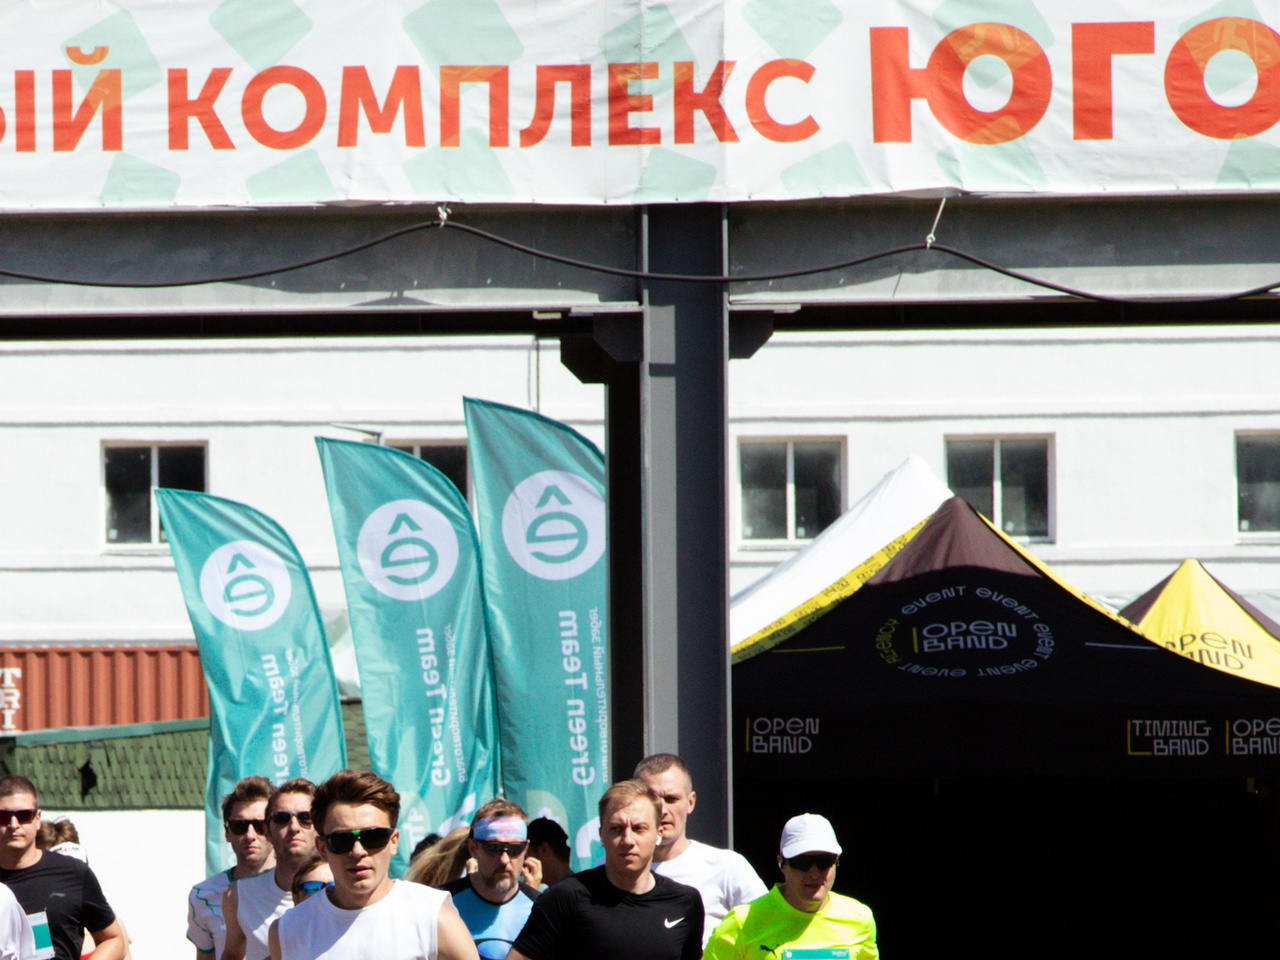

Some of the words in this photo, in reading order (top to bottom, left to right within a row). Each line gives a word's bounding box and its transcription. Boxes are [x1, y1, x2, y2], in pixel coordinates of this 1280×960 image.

[166, 58, 821, 151] КОМПЛЕКС
[869, 16, 1280, 146] ЮГО
[922, 635, 1009, 653] BAND
[1132, 719, 1212, 737] TIMING
[752, 736, 812, 753] BAND
[1153, 739, 1210, 756] BAND
[1232, 737, 1280, 755] BAN
